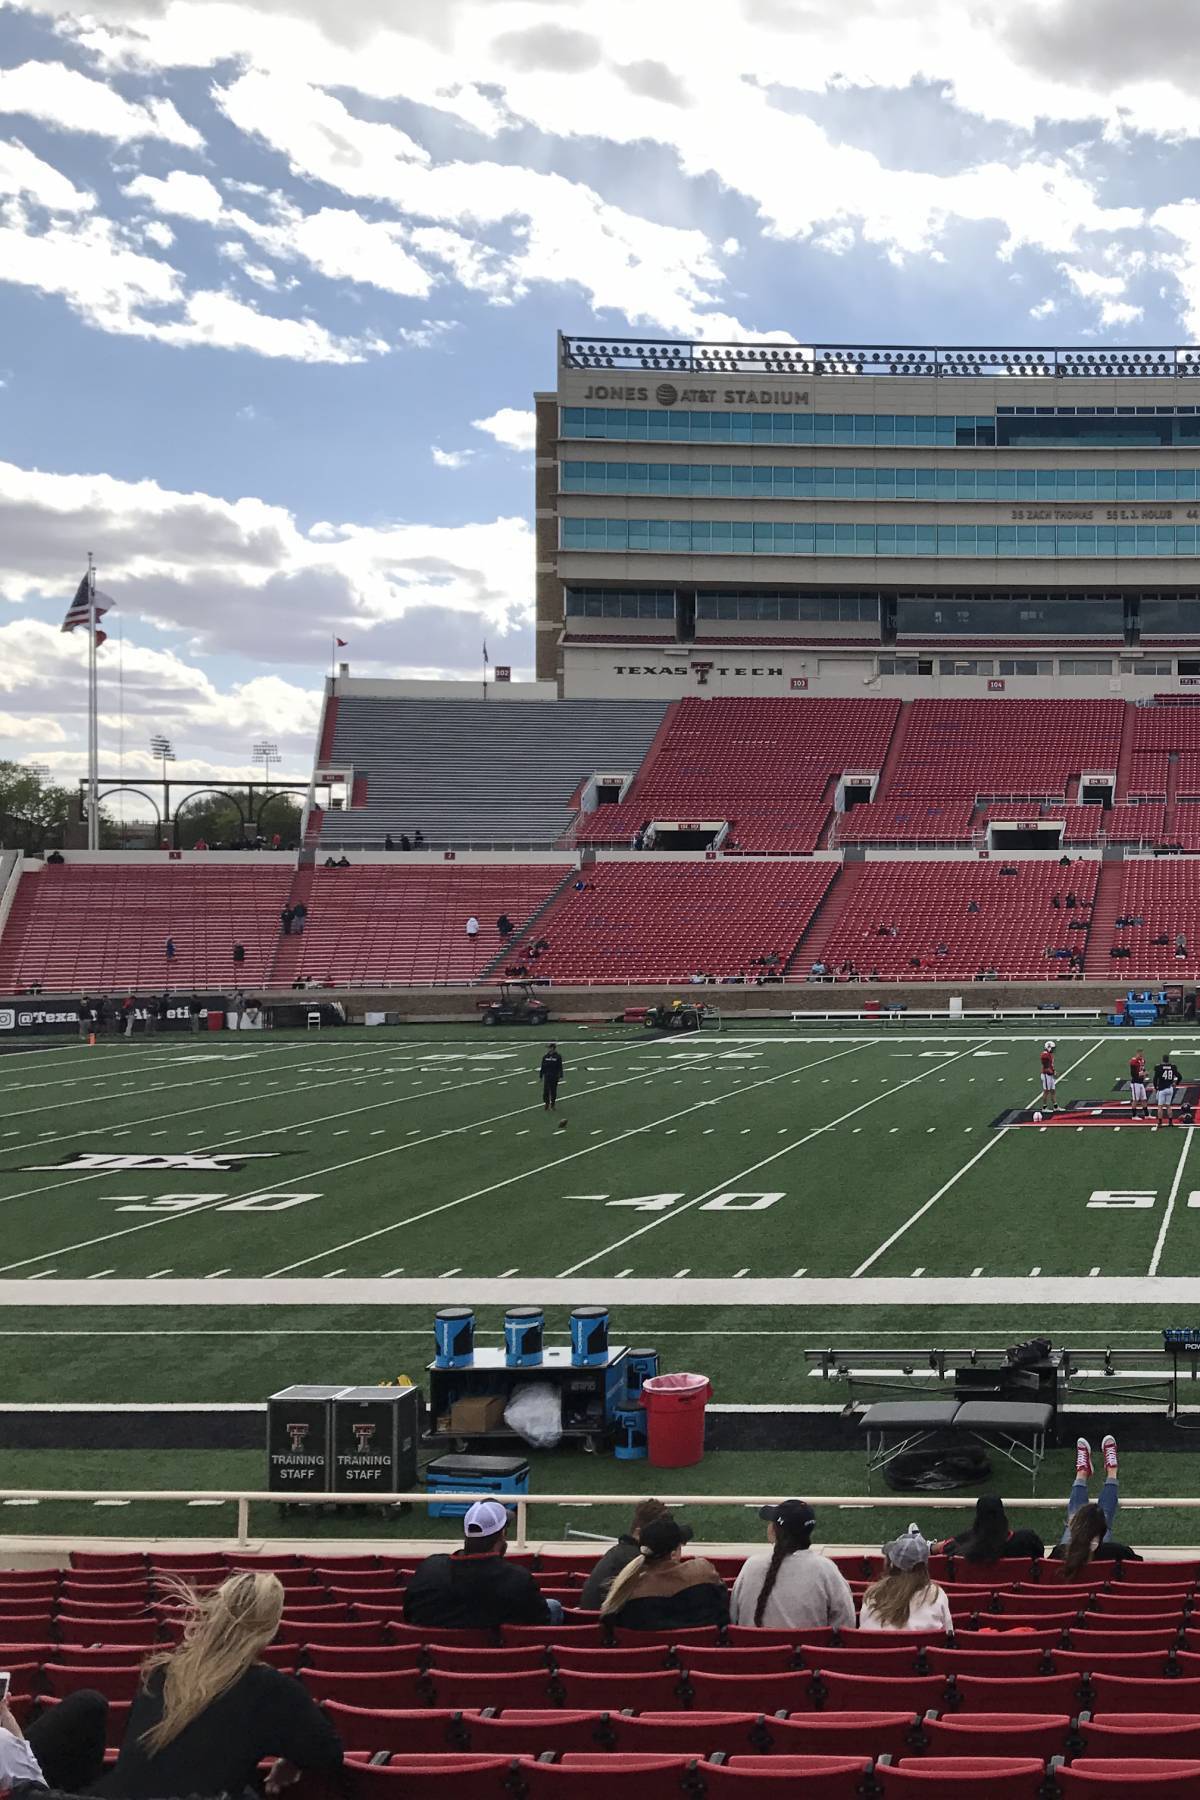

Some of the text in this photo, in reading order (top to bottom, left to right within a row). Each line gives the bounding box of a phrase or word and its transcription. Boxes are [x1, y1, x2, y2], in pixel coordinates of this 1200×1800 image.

[584, 385, 809, 405] JONES AT&T STADIUM
[1027, 510, 1052, 520] ZACH
[1055, 510, 1094, 520] THOMAS
[1141, 509, 1173, 520] HOLUB
[1186, 510, 1199, 519] 44
[614, 666, 689, 676] TEXAS
[717, 668, 783, 676] TECH
[791, 680, 806, 688] 103
[1162, 1070, 1173, 1081] 48
[271, 1454, 325, 1466] TRAINING
[337, 1454, 392, 1466] TRAINING
[280, 1469, 315, 1480] STAFF
[345, 1469, 382, 1480] STAFF
